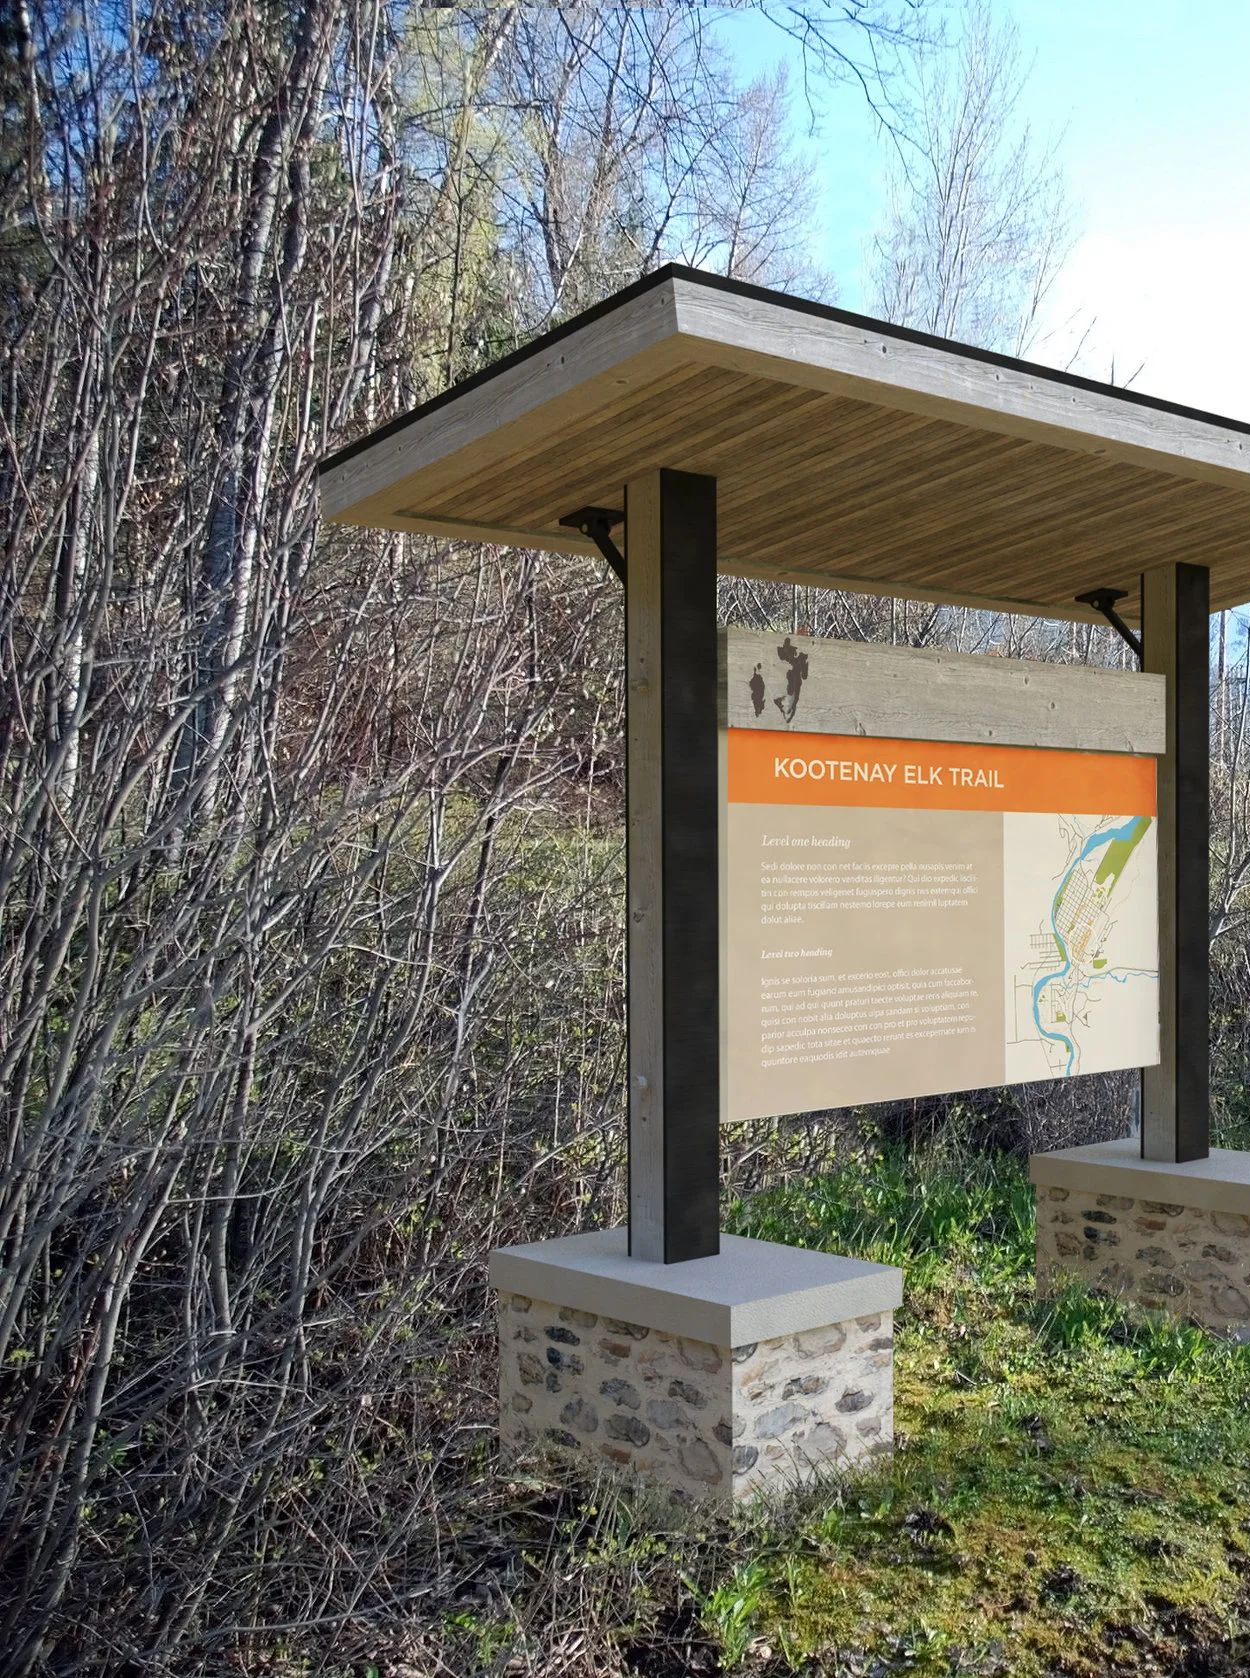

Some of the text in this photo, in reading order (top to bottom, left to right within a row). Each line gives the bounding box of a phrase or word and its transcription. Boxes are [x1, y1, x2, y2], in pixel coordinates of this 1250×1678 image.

[774, 758, 1004, 788] KOOTENAY ELK TRAIL
[762, 835, 851, 849] Level one heading
[780, 861, 805, 871] dolore
[806, 863, 822, 871] non
[823, 863, 837, 871] con
[761, 902, 773, 912] qui
[761, 947, 833, 959] Level two heading
[911, 968, 929, 976] dolor
[928, 980, 943, 988] cum
[781, 1002, 793, 1013] qui
[796, 1001, 805, 1010] ad
[807, 1000, 819, 1010] qui
[782, 1017, 796, 1025] con
[854, 1023, 868, 1032] con
[869, 1022, 883, 1030] con
[884, 1021, 896, 1031] pro
[898, 1019, 905, 1027] et
[906, 1019, 918, 1028] pro
[843, 1037, 851, 1045] et
